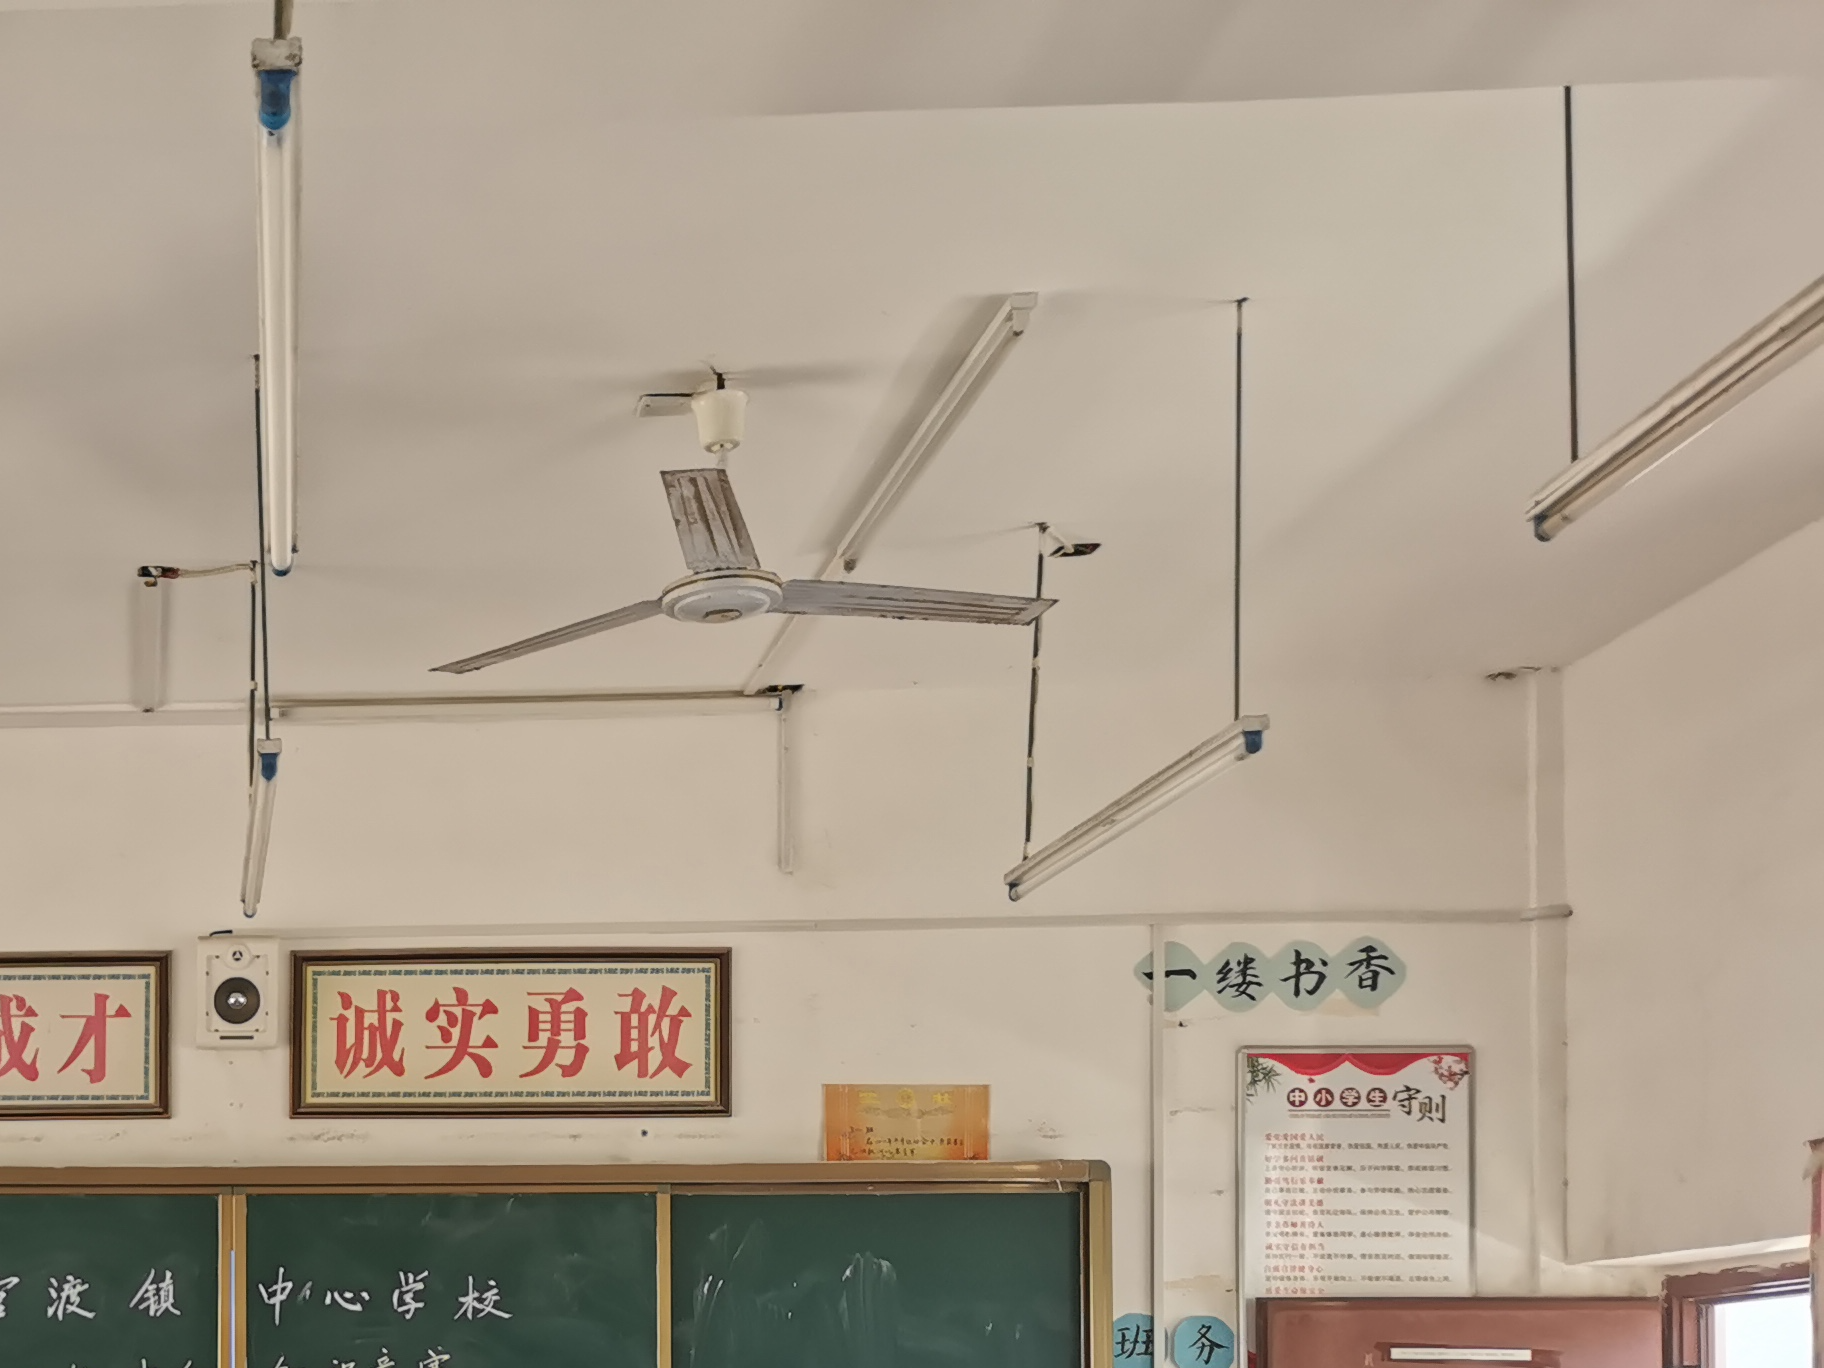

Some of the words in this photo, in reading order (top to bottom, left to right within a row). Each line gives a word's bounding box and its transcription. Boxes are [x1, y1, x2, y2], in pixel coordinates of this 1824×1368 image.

[1142, 945, 1396, 1001] 一缕书香
[329, 985, 693, 1079] 诚实勇敢
[1287, 1085, 1447, 1124] 中小学生守则
[258, 1266, 514, 1326] 中心学校
[1114, 1323, 1231, 1366] 班务
